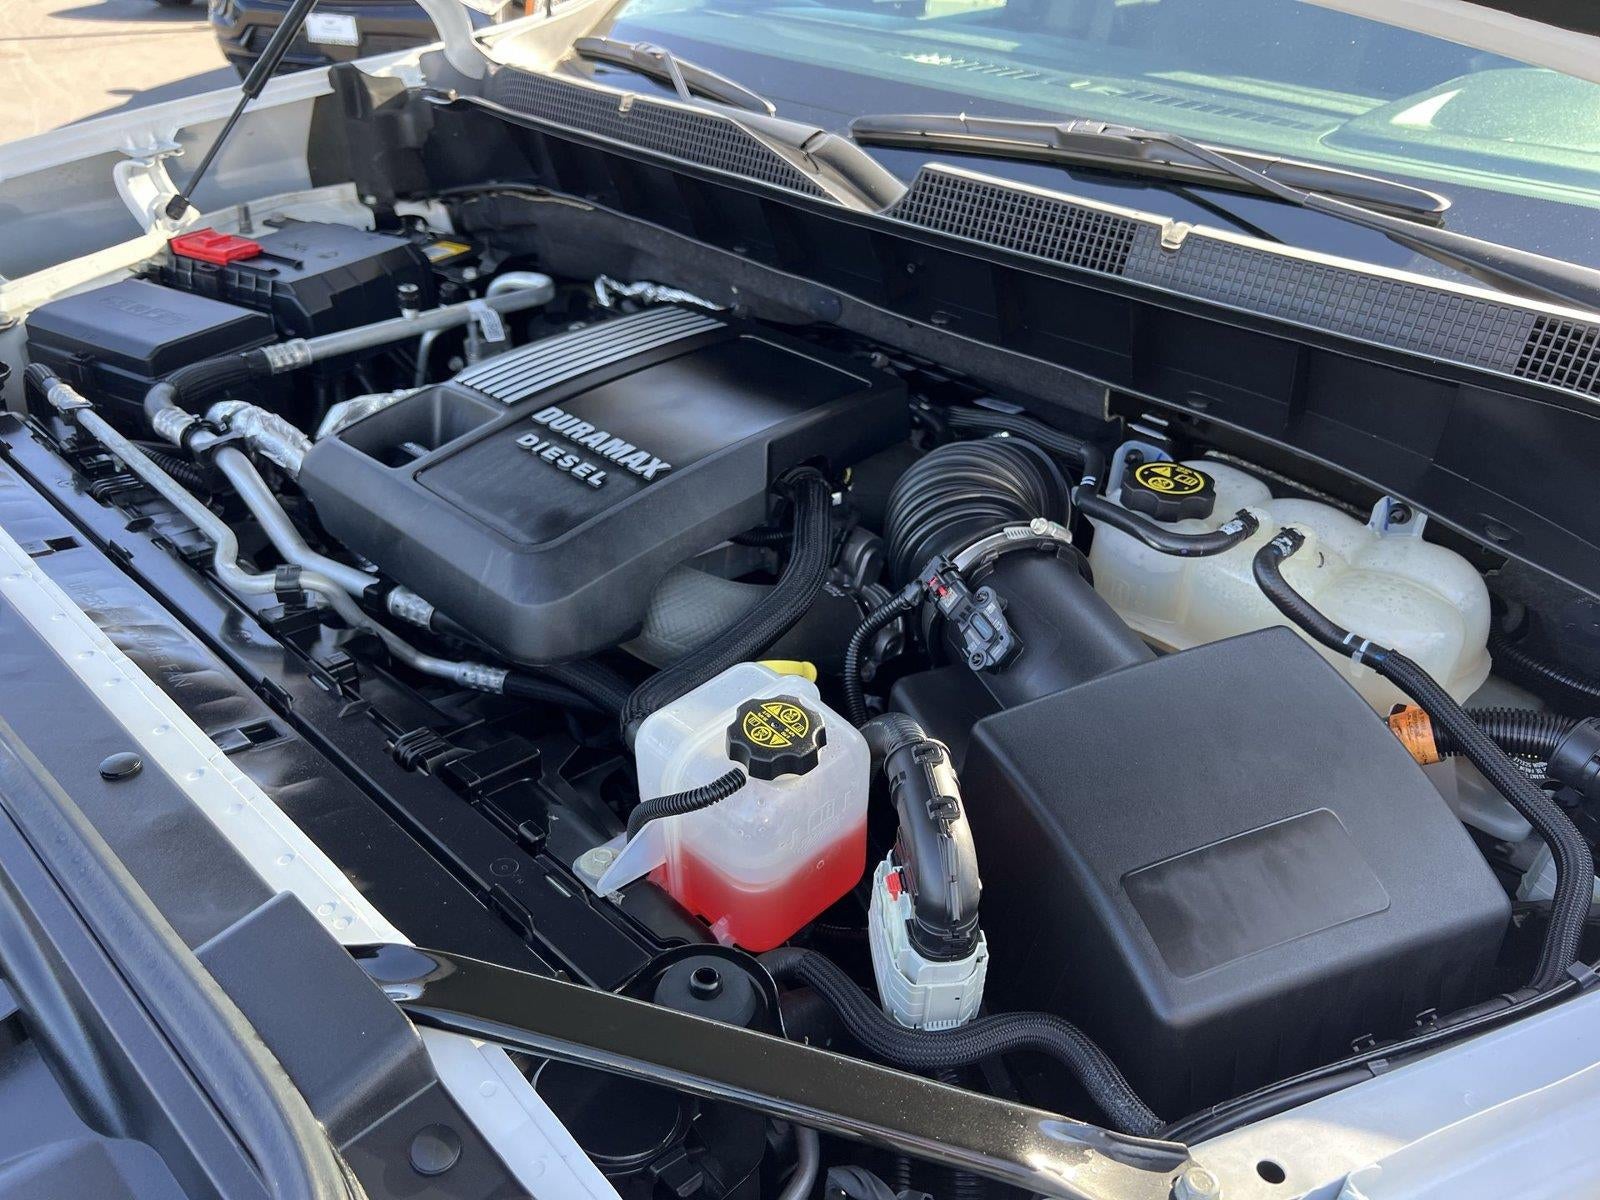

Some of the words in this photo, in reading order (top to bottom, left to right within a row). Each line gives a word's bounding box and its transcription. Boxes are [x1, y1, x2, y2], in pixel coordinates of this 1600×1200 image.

[515, 433, 608, 488] DIESEL
[532, 405, 672, 481] DURAMAX
[158, 663, 193, 688] FAN
